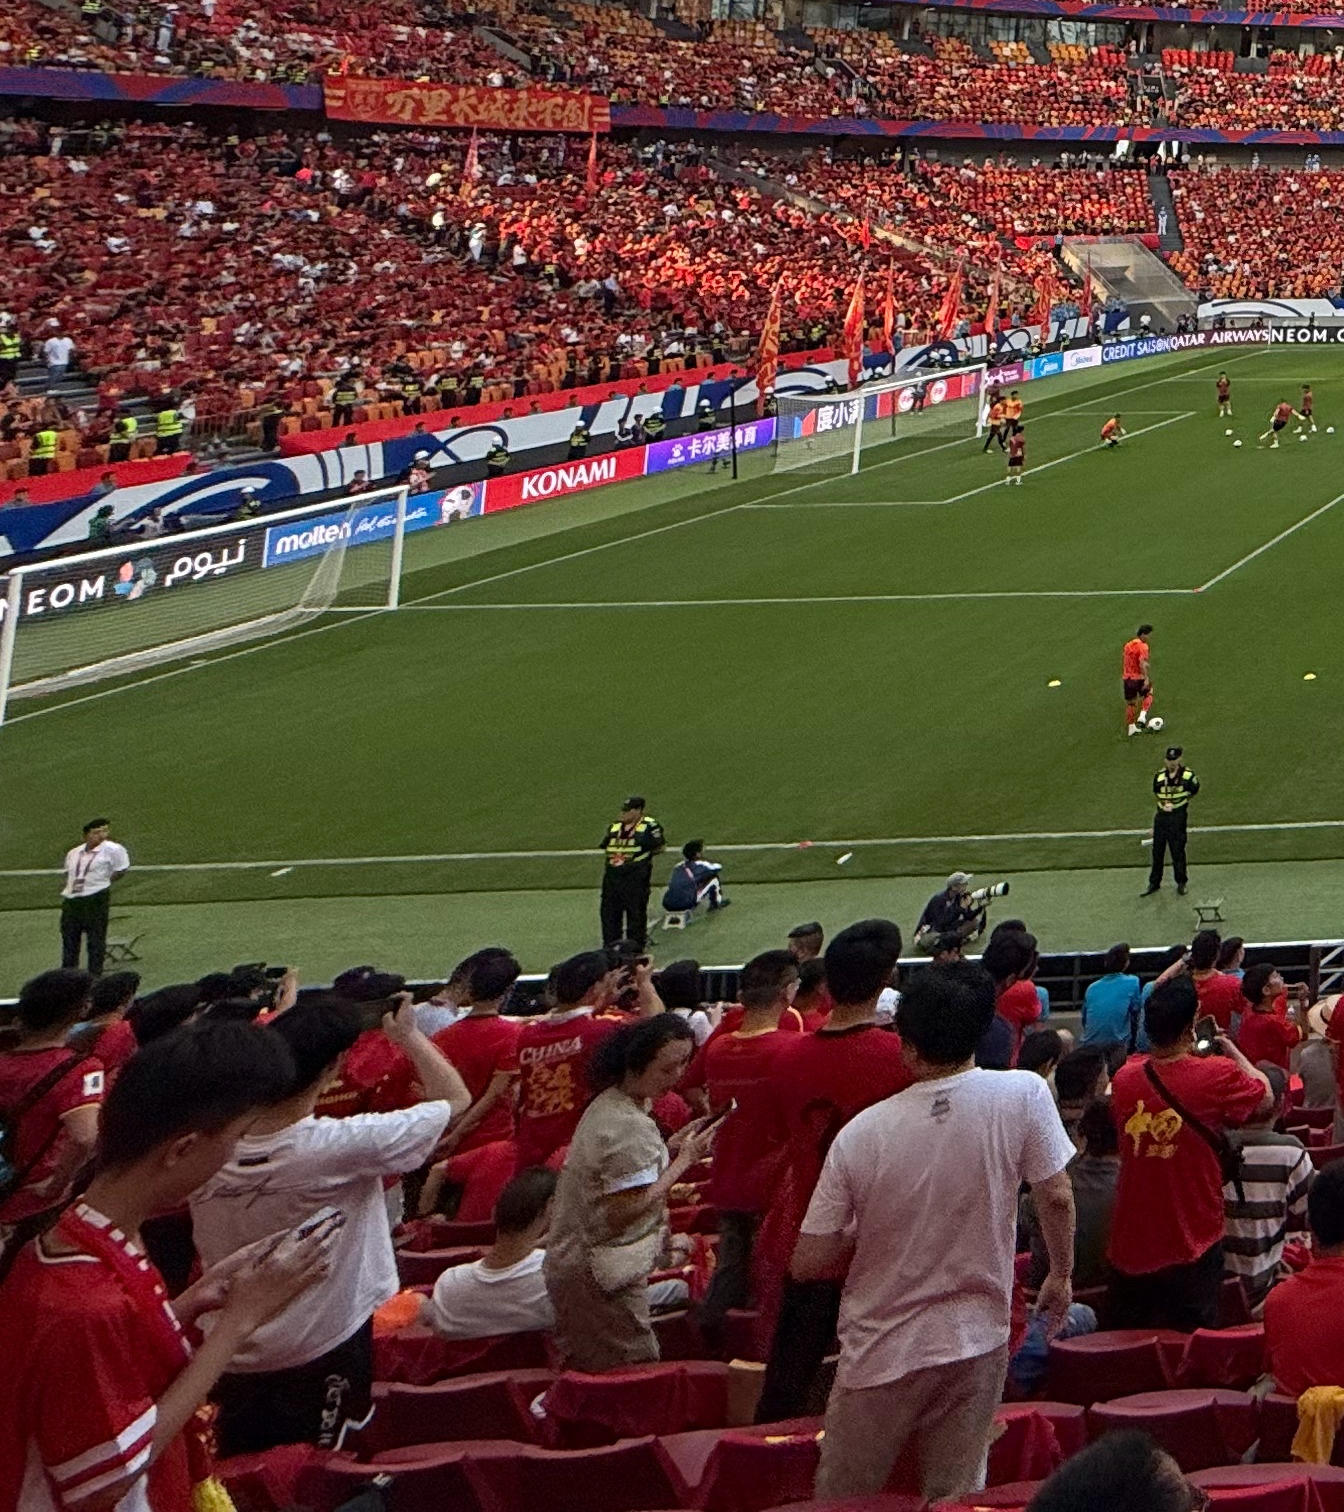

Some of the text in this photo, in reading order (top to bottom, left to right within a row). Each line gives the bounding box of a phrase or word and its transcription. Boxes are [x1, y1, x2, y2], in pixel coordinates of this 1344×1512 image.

[1102, 338, 1170, 361] CREDIT SAISON
[1171, 329, 1269, 351] QATAR AIRWAYS
[521, 457, 617, 500] KONAMI
[275, 521, 351, 555] molten
[164, 538, 248, 588] نيوم
